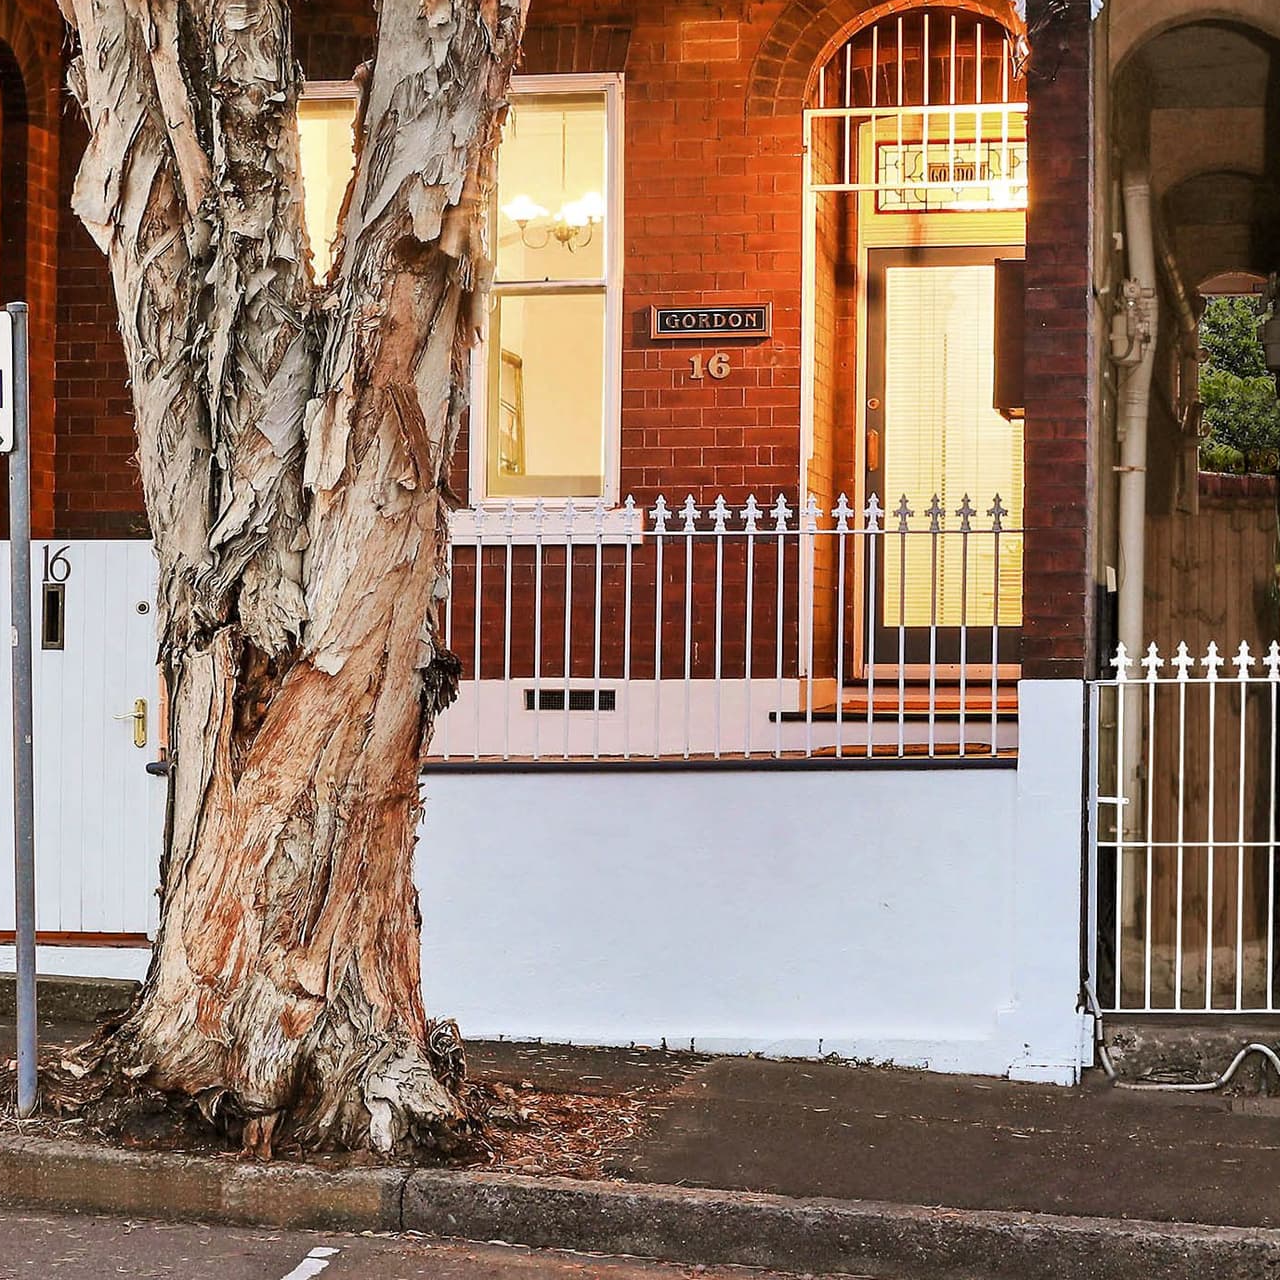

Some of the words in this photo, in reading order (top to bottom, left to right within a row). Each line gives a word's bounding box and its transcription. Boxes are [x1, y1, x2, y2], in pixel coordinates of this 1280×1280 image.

[930, 167, 986, 182] GODO
[665, 313, 757, 329] GORDON
[689, 352, 731, 380] 16
[42, 544, 71, 582] 16
